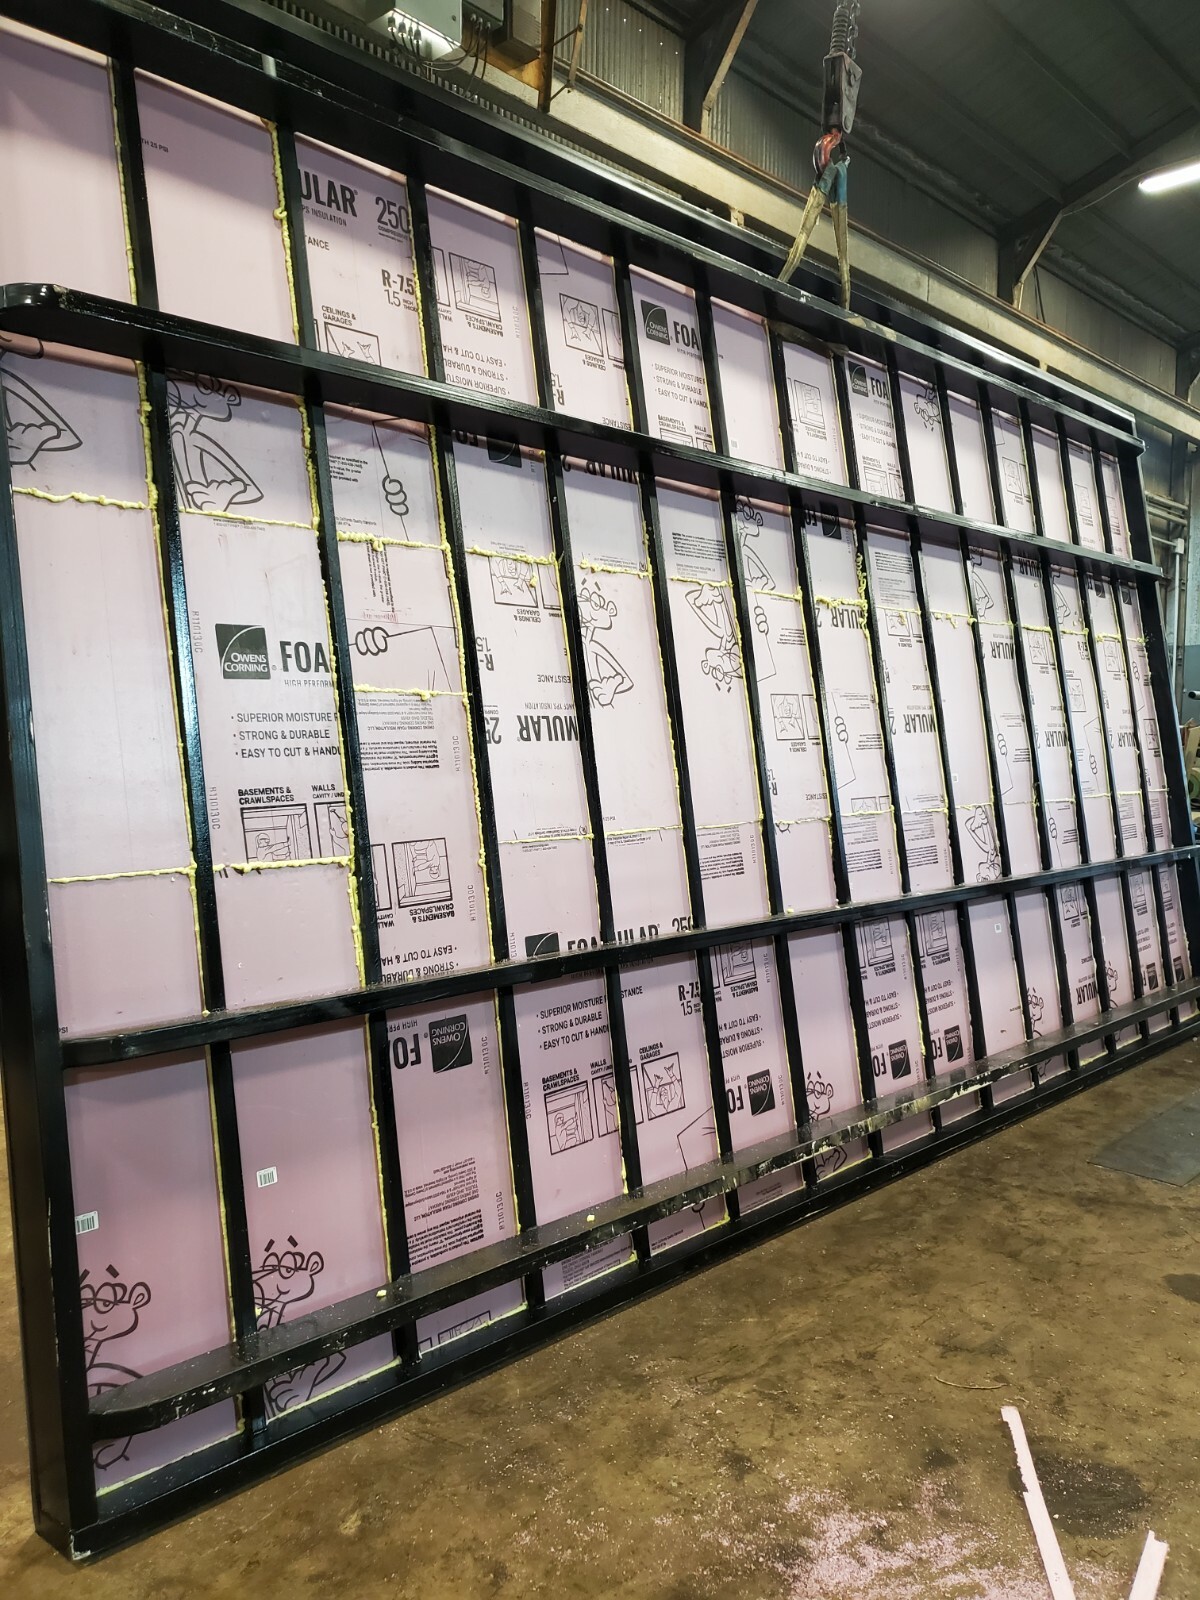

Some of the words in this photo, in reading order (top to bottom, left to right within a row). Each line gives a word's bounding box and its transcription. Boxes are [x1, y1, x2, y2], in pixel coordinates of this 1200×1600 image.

[312, 208, 347, 226] INSULATION
[375, 196, 410, 234] 250
[382, 269, 414, 296] R-7.5
[384, 290, 400, 307] 1.5
[322, 305, 350, 318] CEILINGS
[322, 312, 352, 326] GARAGES
[465, 314, 502, 330] CRAWLSPACES
[472, 324, 504, 337] BASEMENTS
[646, 327, 668, 340] CORNING
[649, 321, 668, 333] OWENS
[454, 346, 458, 354] &
[461, 348, 474, 360] CUT
[476, 352, 484, 362] TO
[486, 355, 502, 368] EASY
[471, 365, 476, 374] &
[478, 367, 504, 381] STRONG
[654, 363, 678, 377] SUPERIOR
[678, 370, 702, 384] MOISTURE
[474, 380, 506, 395] SUPERIOR
[656, 376, 676, 388] STRONG
[681, 384, 702, 396] DURABLE
[658, 388, 670, 398] EASY
[672, 390, 678, 400] TO
[678, 393, 688, 402] CUT
[516, 608, 540, 616] GARAGES
[230, 652, 266, 663] OWENS
[280, 640, 330, 673] FOA
[224, 662, 268, 672] CORNING
[284, 679, 302, 687] HIGH
[236, 712, 284, 722] SUPERIOR
[286, 712, 332, 722] MOISTURE
[516, 714, 578, 742] MULAR
[240, 730, 278, 740] STRONG
[281, 730, 287, 740] &
[289, 730, 330, 740] DURABLE
[242, 748, 264, 758] EASY
[268, 748, 280, 758] TO
[284, 747, 302, 757] CUT
[305, 747, 310, 756] &
[238, 786, 284, 796] BASEMENTS
[286, 786, 292, 794] &
[312, 784, 336, 792] WALLS
[239, 794, 294, 805] CRAWLSPACES
[208, 786, 220, 830] R110130C
[409, 903, 454, 916] CRAWLSPACES
[418, 910, 455, 923] BASEMENTS
[403, 952, 418, 962] CUT
[421, 948, 432, 958] TO
[433, 944, 452, 957] EASY
[395, 955, 400, 963] &
[416, 967, 421, 976] &
[426, 961, 454, 974] STRONG
[730, 980, 758, 992] CRAWLSPACES
[736, 986, 758, 997] BASEMENTS
[540, 1003, 572, 1020] SUPERIOR
[572, 996, 604, 1012] MOISTURE
[680, 1000, 692, 1016] 1.5
[883, 1004, 898, 1014] STRONG
[402, 1020, 418, 1030] HIGH
[542, 1022, 568, 1035] STRONG
[570, 1019, 574, 1028] &
[575, 1011, 602, 1026] DURABLE
[728, 1020, 738, 1030] CUT
[739, 1018, 746, 1026] TO
[748, 1014, 759, 1025] EASY
[881, 1014, 900, 1026] SUPERIOR
[432, 1022, 465, 1036] CORNING
[740, 1027, 760, 1040] STRONG
[432, 1033, 460, 1046] OWENS
[544, 1038, 560, 1050] EASY
[561, 1036, 570, 1044] TO
[572, 1030, 584, 1042] CUT
[585, 1030, 590, 1038] &
[639, 1044, 659, 1054] CEILINGS
[740, 1040, 762, 1054] SUPERIOR
[640, 1050, 660, 1061] GARAGES
[590, 1058, 606, 1069] WALLS
[542, 1070, 573, 1084] BASEMENTS
[543, 1075, 580, 1092] CRAWLSPACES
[748, 1074, 770, 1086] CORNING
[750, 1084, 767, 1095] OWENS
[496, 1191, 505, 1230] R110130C
